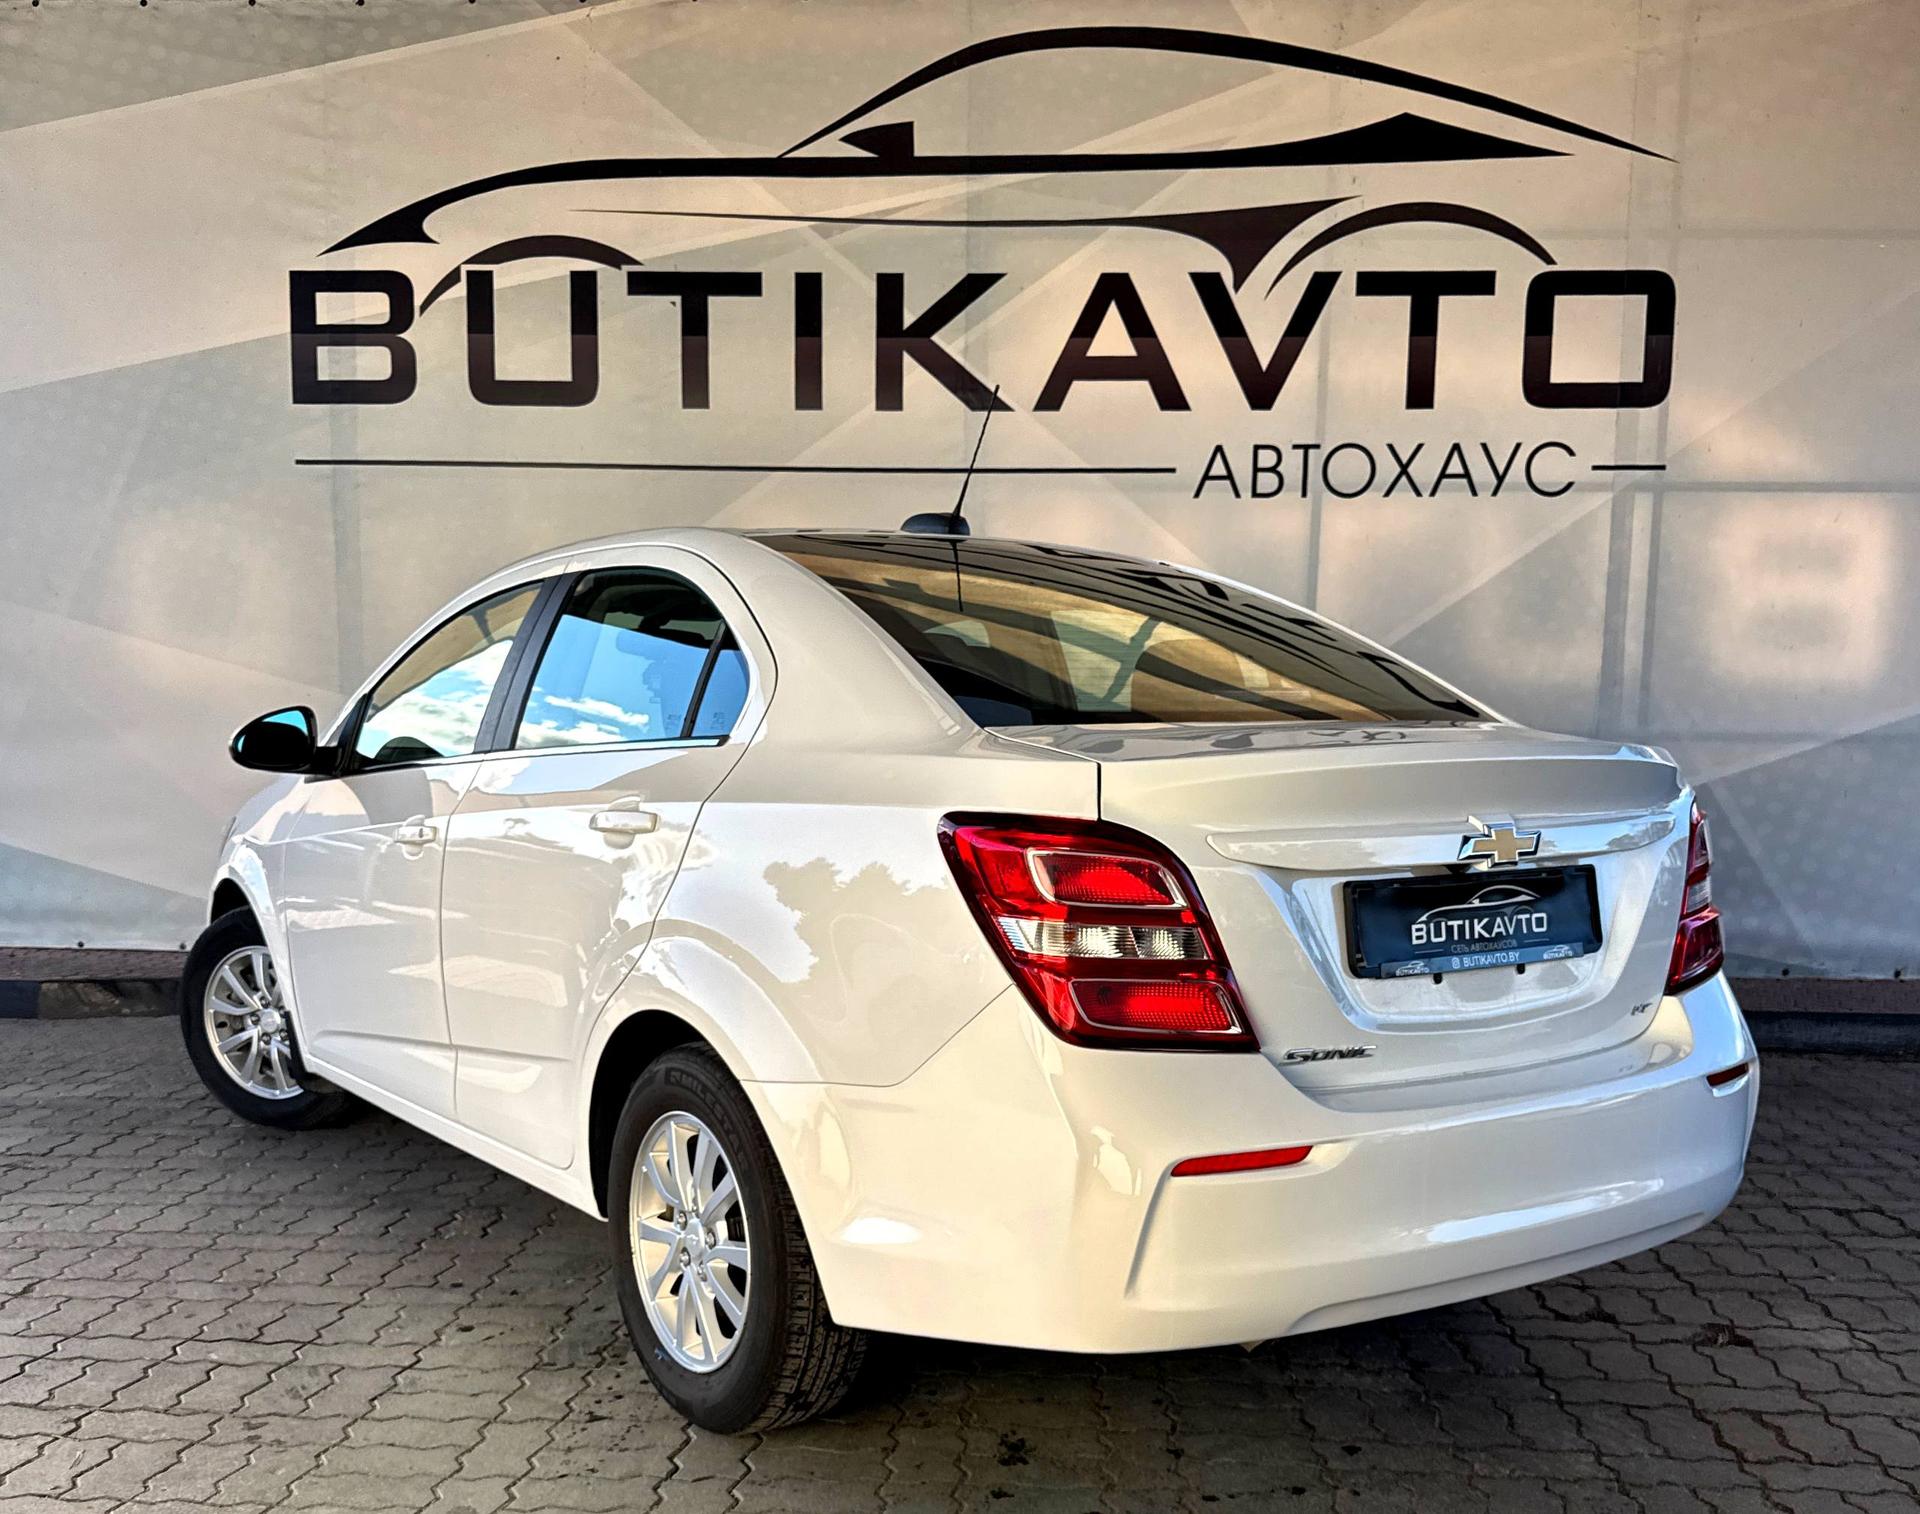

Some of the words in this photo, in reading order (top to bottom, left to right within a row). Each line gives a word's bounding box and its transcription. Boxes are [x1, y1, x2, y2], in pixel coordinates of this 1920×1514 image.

[290, 268, 1676, 411] BUTIKAVTO
[1193, 441, 1577, 499] АВТОХАУС
[1411, 912, 1548, 945] BUTIKAVTO
[1280, 1045, 1377, 1066] SONIC
